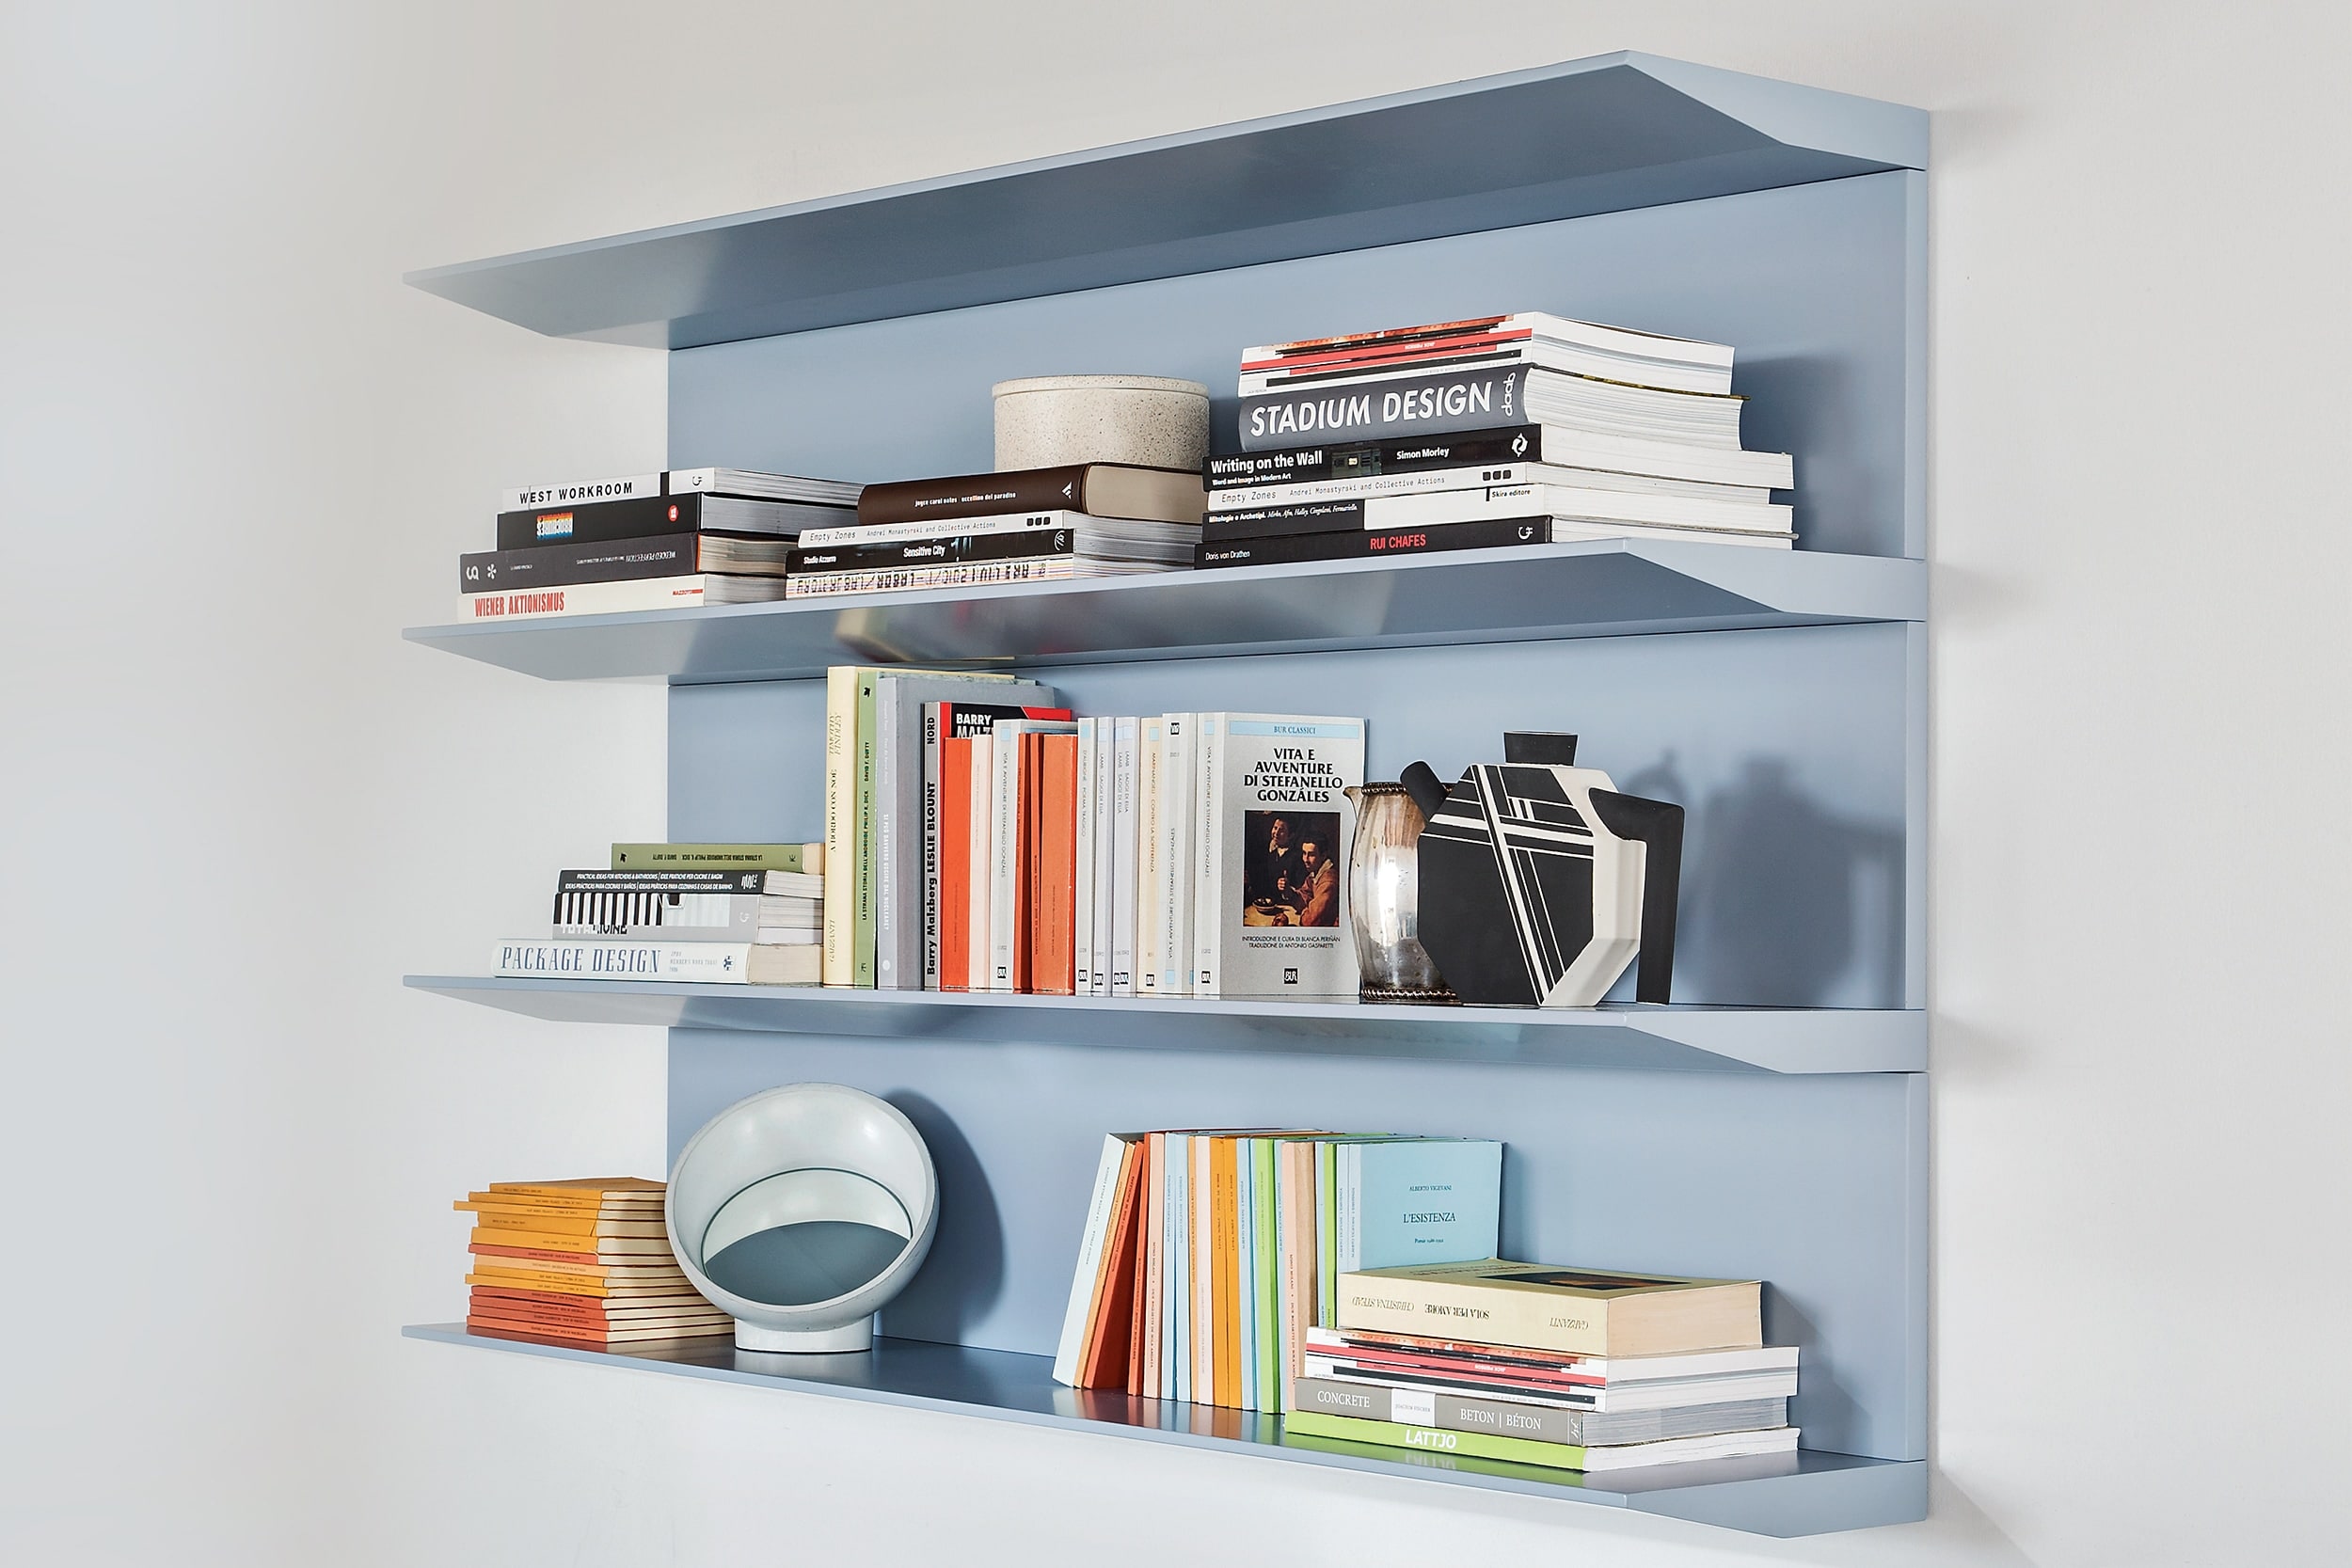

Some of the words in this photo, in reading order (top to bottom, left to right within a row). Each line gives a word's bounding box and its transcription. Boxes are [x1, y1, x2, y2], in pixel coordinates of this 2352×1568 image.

[1501, 372, 1517, 418] daab
[1249, 394, 1371, 437] STADIUM
[1382, 381, 1494, 422] DESIGN
[1396, 450, 1421, 460] Simon
[1422, 447, 1450, 459] Morley
[1211, 459, 1255, 474] Writing
[1257, 459, 1272, 469] on
[1274, 454, 1295, 468] the
[1295, 450, 1323, 466] Wall
[1238, 477, 1254, 485] Image
[519, 490, 552, 504] WEST
[559, 482, 634, 500] WORKROOM
[1315, 485, 1357, 496] Monastyrski
[1375, 480, 1414, 489] Collective
[993, 492, 1016, 500] paradiso
[1221, 493, 1247, 504] Empty
[1251, 491, 1277, 500] Zones
[914, 499, 929, 508] joyce
[888, 527, 922, 536] Monastyrski
[939, 523, 970, 531] Collective
[810, 532, 831, 543] Empty
[835, 531, 856, 540] Zones
[1370, 536, 1386, 550] RUI
[1389, 534, 1426, 548] CHAFES
[903, 546, 932, 558] Sensitive
[933, 545, 946, 557] City
[1205, 552, 1219, 561] Doris
[1231, 550, 1250, 559] Drathen
[803, 556, 818, 564] Studio
[474, 596, 505, 617] WIENER
[508, 592, 565, 615] AKTIONISMUS
[956, 713, 992, 725] BARRY
[927, 717, 935, 745] NORD
[1274, 748, 1304, 760] VITA
[1308, 749, 1315, 760] E
[1254, 761, 1334, 775] AVVENTURE
[1244, 775, 1258, 786] DI
[1262, 776, 1343, 788] STEFANELLO
[1257, 788, 1330, 803] GONZÁLES
[927, 782, 935, 831] BLOUNT
[927, 835, 935, 873] LESLIE
[926, 878, 938, 936] Malzberg
[501, 946, 584, 971] PACKAGE
[592, 948, 661, 973] DESIGN
[926, 941, 937, 974] Barry
[1285, 970, 1297, 982] BUR
[1403, 1212, 1456, 1224] L'ESISTENZA
[1351, 1296, 1375, 1308] STEAD
[1375, 1298, 1415, 1311] CHRISTINA
[1424, 1304, 1451, 1315] AMORE
[1453, 1307, 1468, 1318] PER
[1470, 1308, 1490, 1320] SOLA
[1549, 1317, 1589, 1330] GARZANTI
[1317, 1390, 1370, 1408] CONCRETE
[1460, 1409, 1495, 1424] BETON
[1506, 1413, 1542, 1430] BÉTON
[1406, 1429, 1456, 1449] LATTJO
